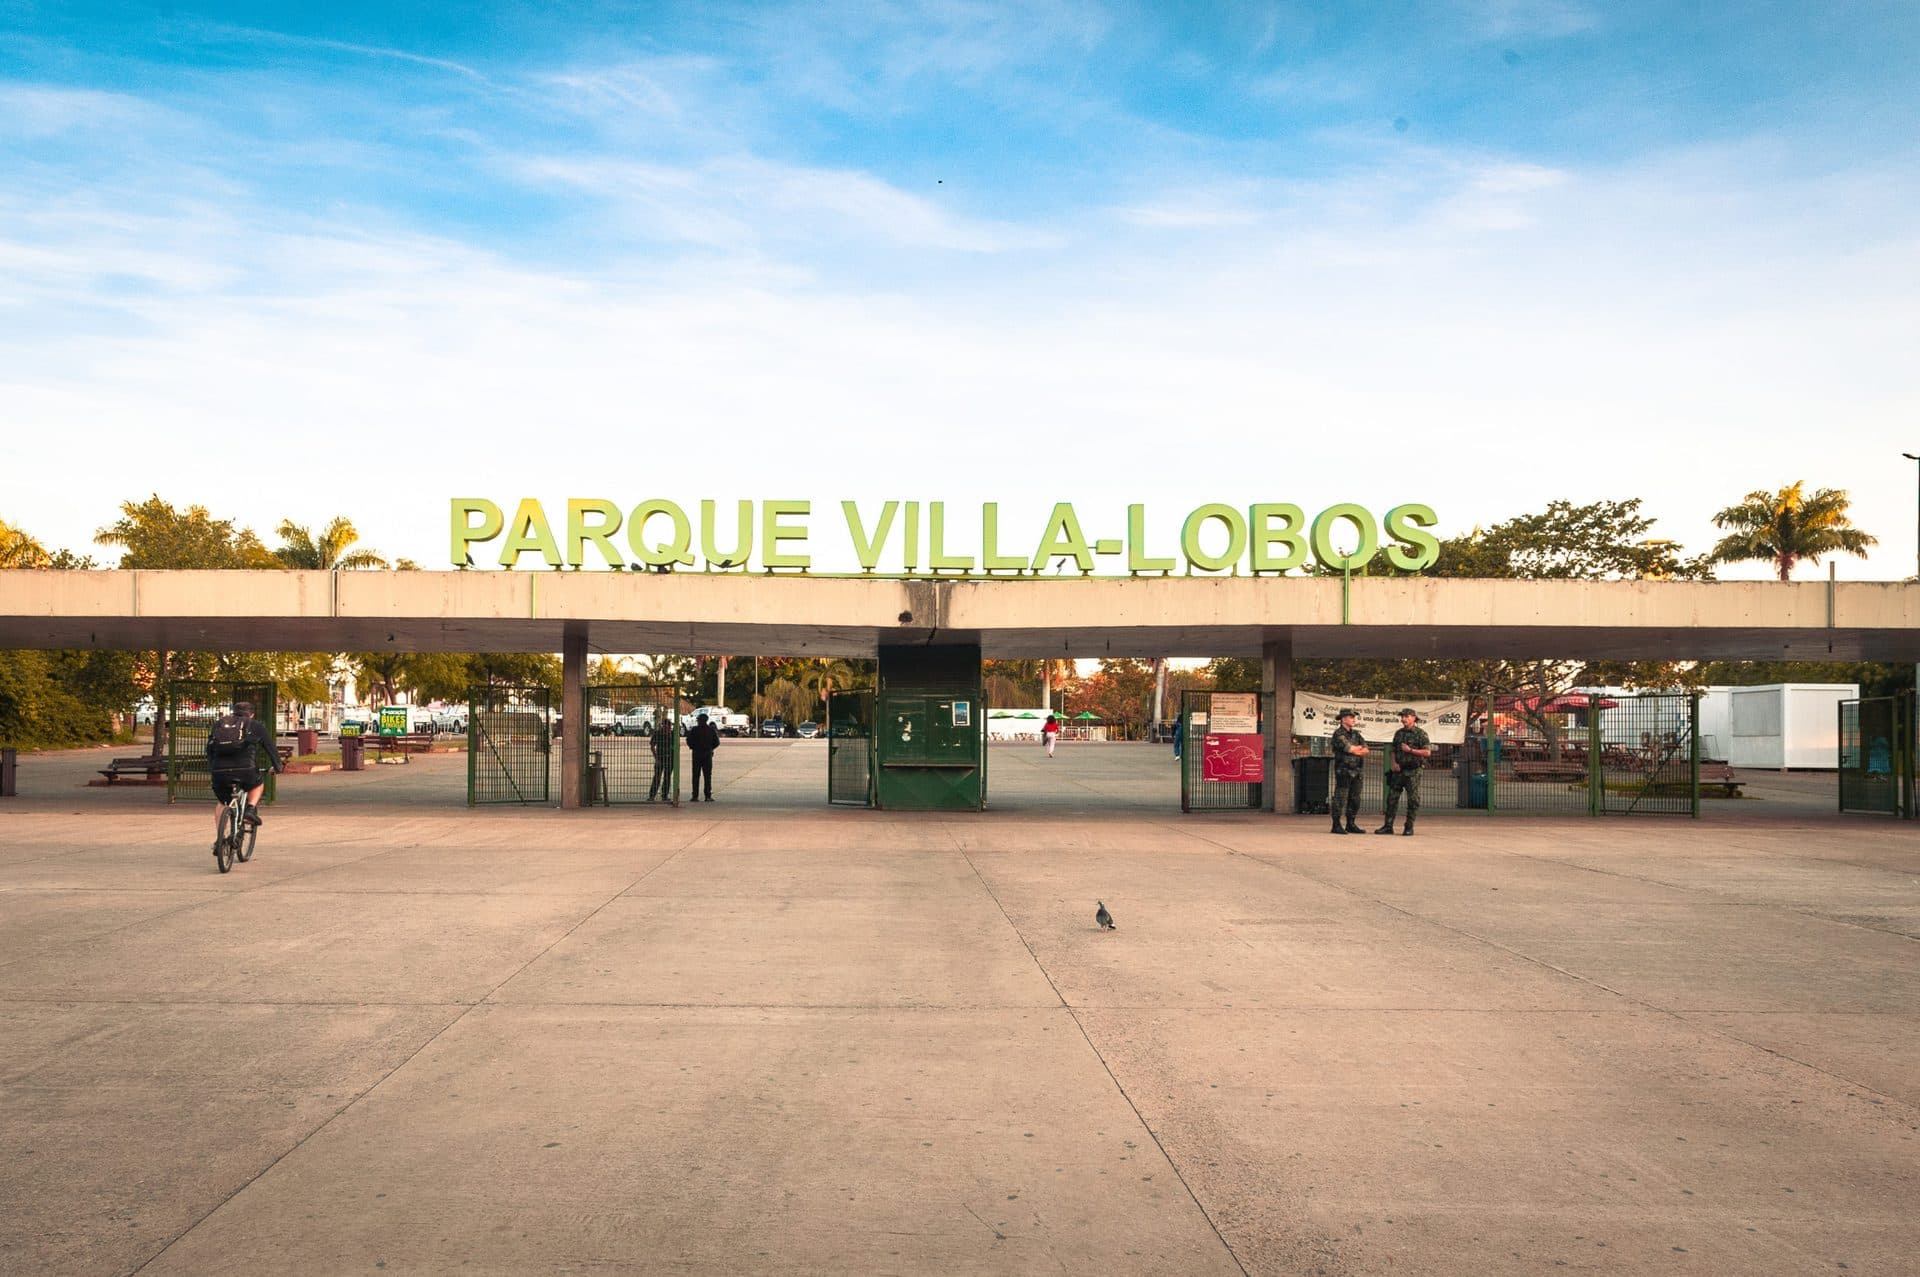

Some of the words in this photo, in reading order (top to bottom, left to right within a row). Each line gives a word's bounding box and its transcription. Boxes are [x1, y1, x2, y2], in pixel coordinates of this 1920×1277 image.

[451, 498, 810, 568] PARQUE
[841, 501, 1440, 572] VILLA-LOBOS
[381, 715, 406, 724] BIKES
